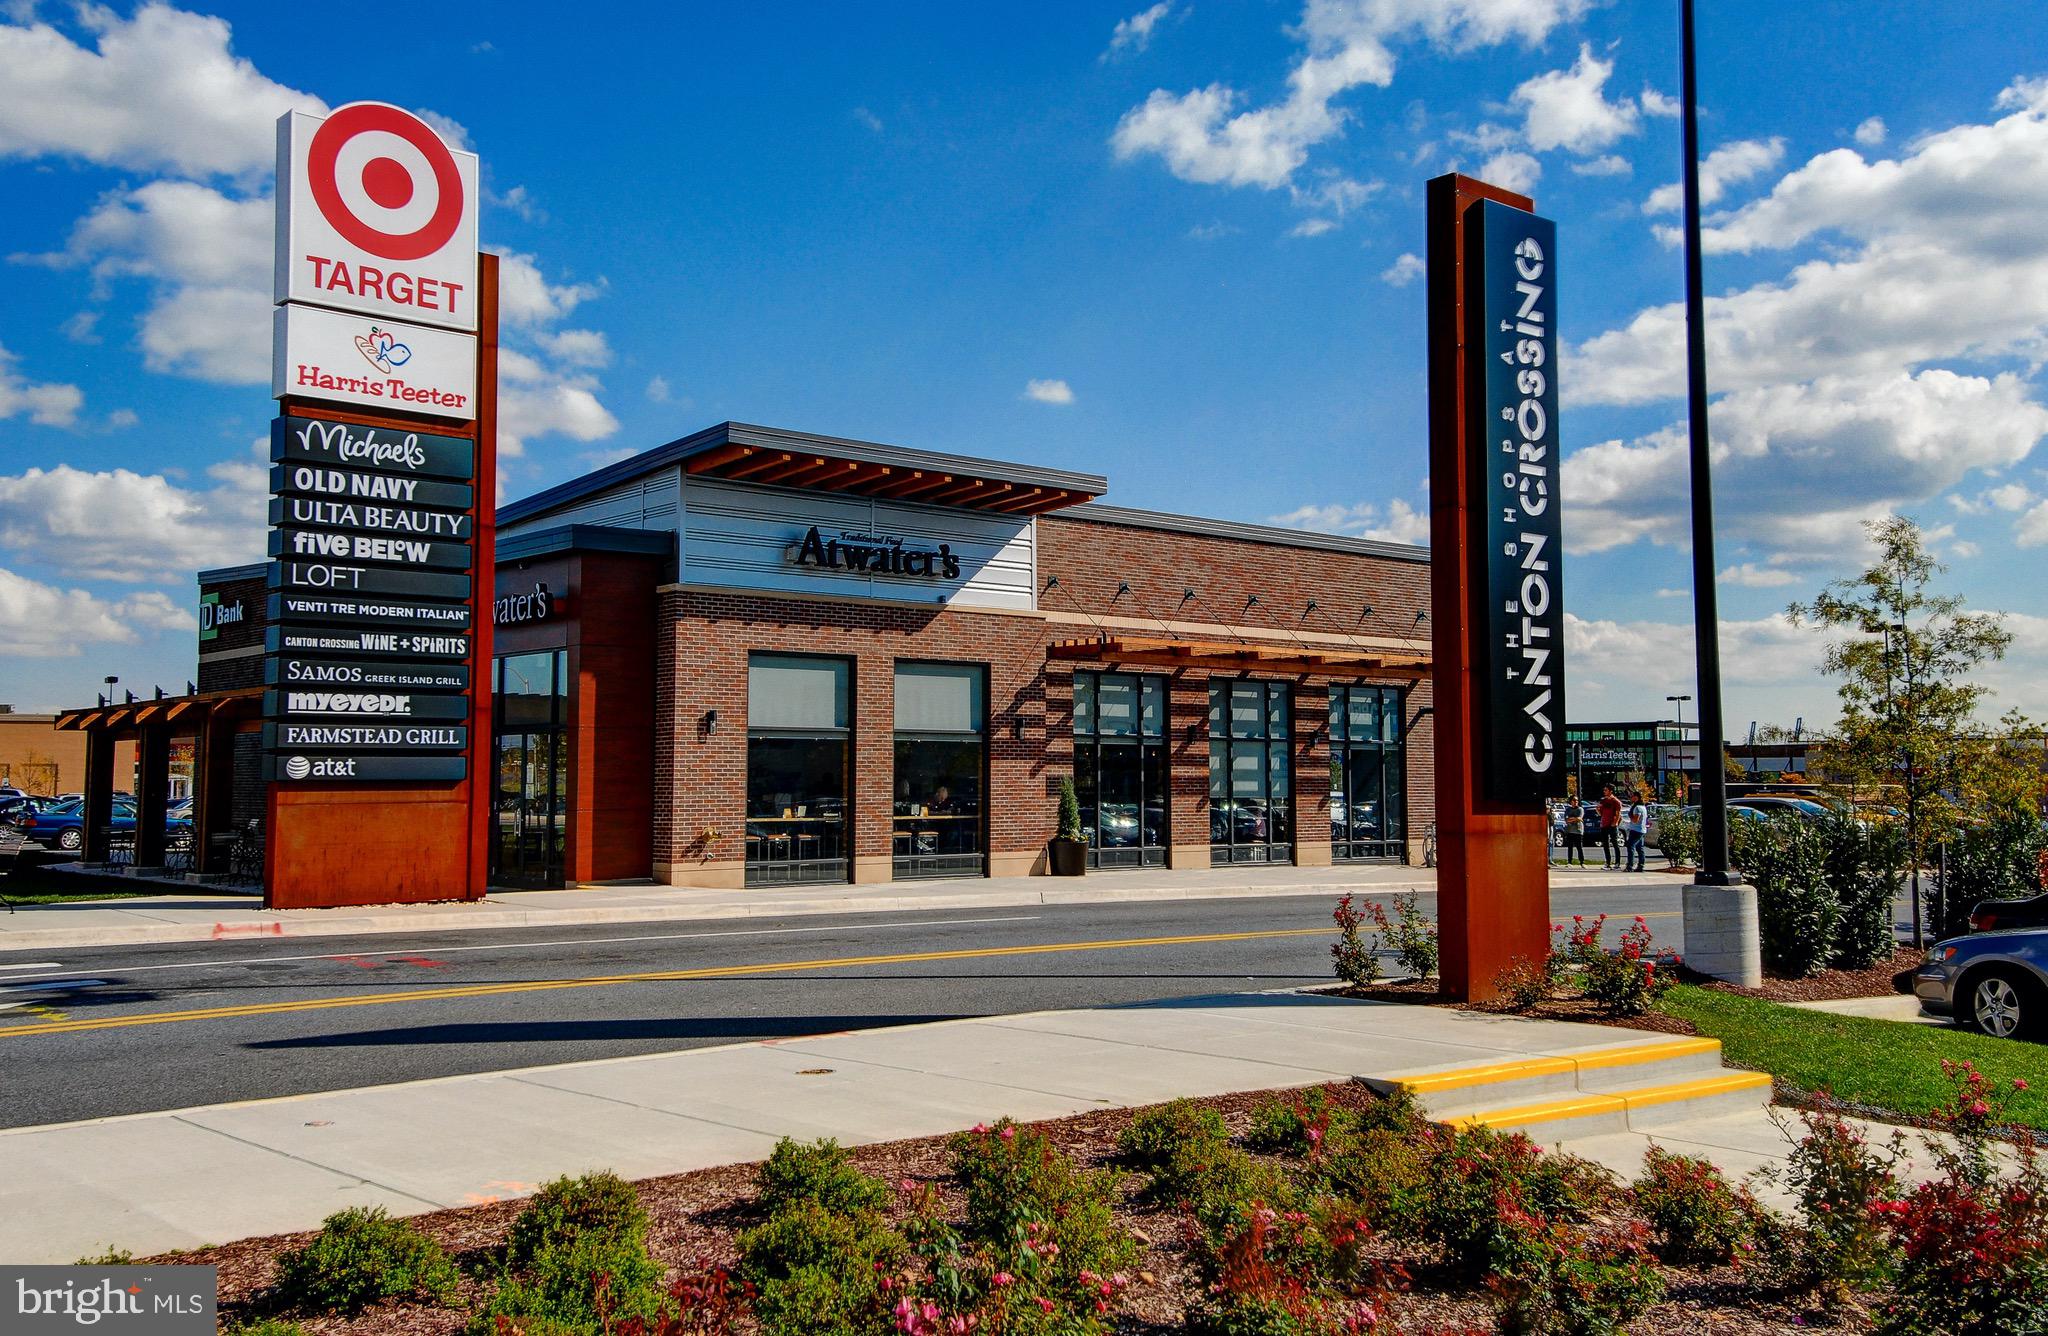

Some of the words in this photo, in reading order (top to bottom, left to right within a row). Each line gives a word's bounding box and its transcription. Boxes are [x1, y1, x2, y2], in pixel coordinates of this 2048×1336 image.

[306, 255, 463, 313] TARGET
[1500, 319, 1515, 366] AT
[297, 364, 384, 397] Harris
[387, 379, 467, 408] Teeter
[1514, 237, 1548, 517] CROSSING
[296, 420, 426, 470] Michaels
[294, 467, 346, 494] OLD
[351, 474, 418, 501] NAVY
[1502, 406, 1518, 557] SHOPS
[293, 499, 359, 526] ULTA
[365, 506, 464, 535] BEAUTY
[293, 532, 350, 556] five
[794, 525, 961, 579] Atwater's
[292, 563, 366, 589] LOFT
[199, 602, 213, 631] TD
[216, 599, 244, 625] Bank
[287, 600, 328, 613] VENTI
[330, 603, 356, 614] TRE
[358, 605, 414, 618] MODERN
[285, 636, 318, 648] CANTON
[319, 638, 360, 650] CROSSING
[400, 639, 410, 649] +
[1506, 600, 1520, 680] THE
[1520, 532, 1553, 773] CANTON
[287, 661, 362, 683] SAMOS
[364, 674, 396, 684] GREEK
[398, 676, 433, 685] ISLAND
[435, 677, 462, 686] GRILL
[287, 727, 402, 744] FARMSTEAD
[405, 729, 460, 745] GRILL
[1607, 750, 1638, 759] Teeter
